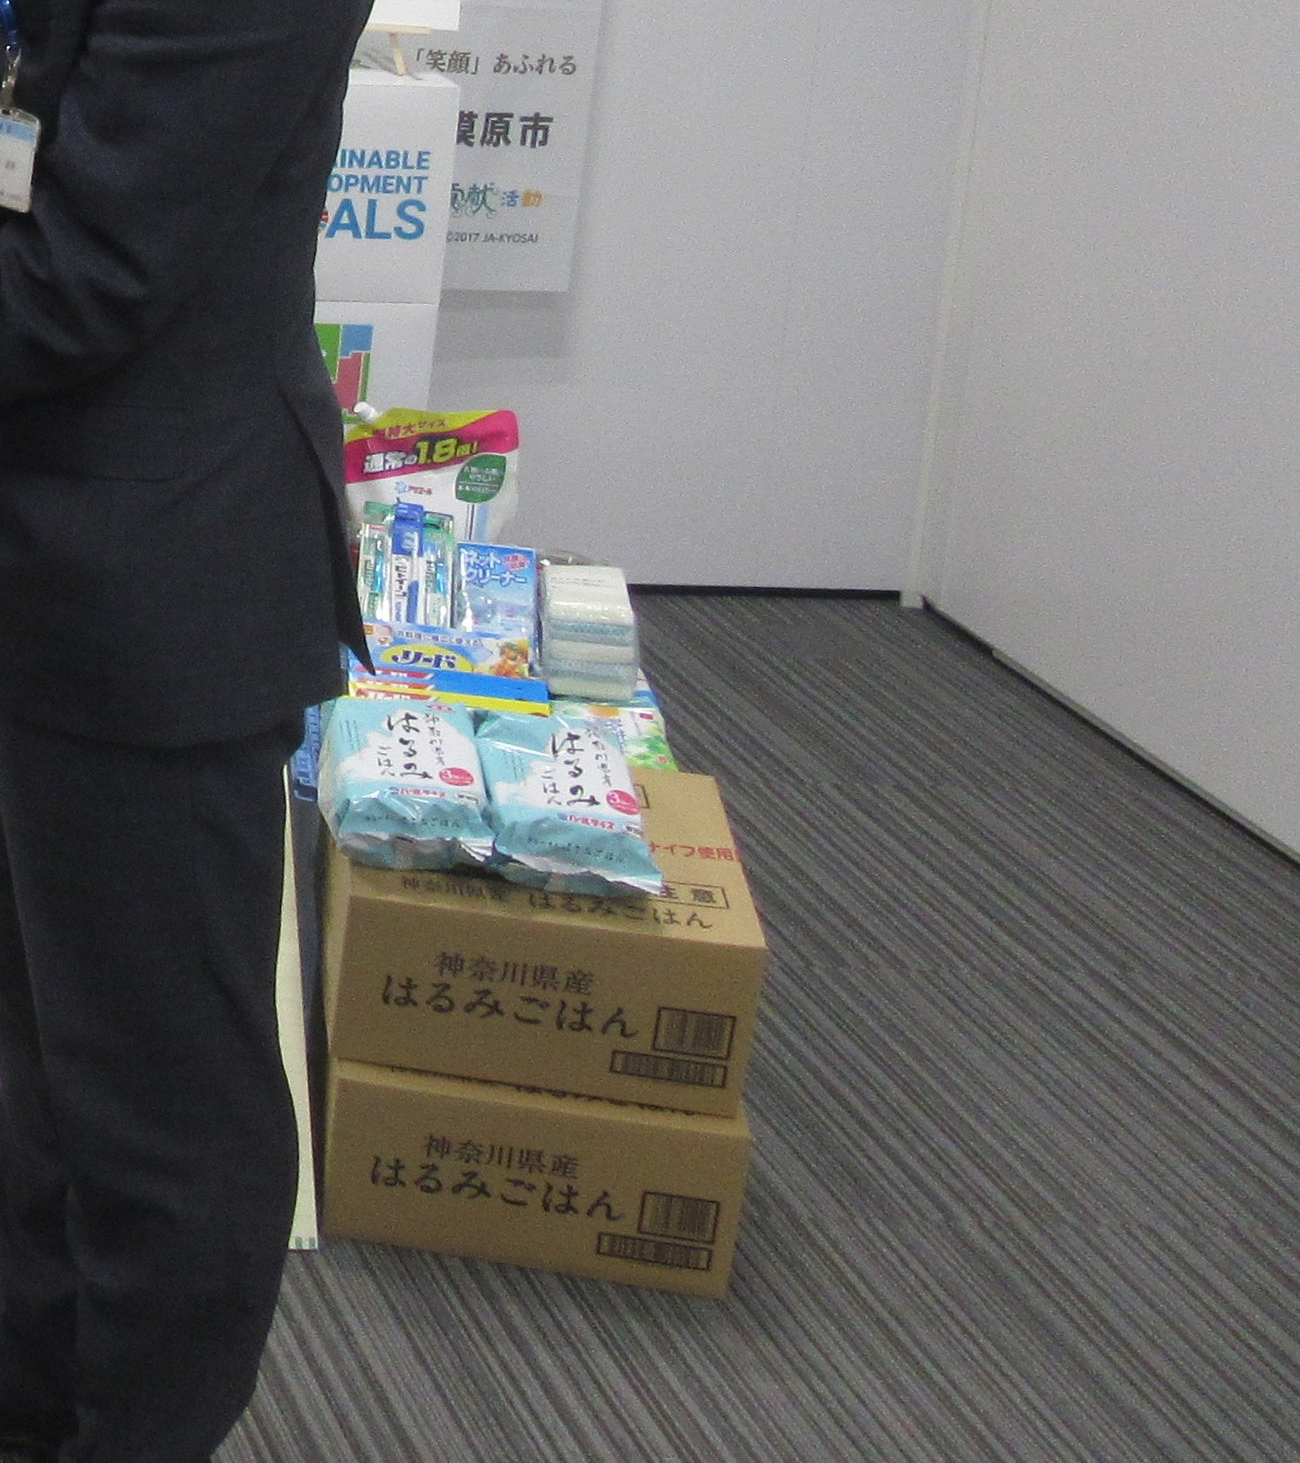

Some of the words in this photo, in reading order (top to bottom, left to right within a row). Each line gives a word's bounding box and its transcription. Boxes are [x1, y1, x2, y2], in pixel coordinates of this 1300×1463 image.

[415, 48, 577, 75] 「笑顔」あふれる
[433, 951, 595, 996] 神奈川県産
[382, 974, 639, 1040] はるみごはん
[424, 1134, 580, 1180] 神奈川県産
[370, 1154, 626, 1222] はるみごはん
